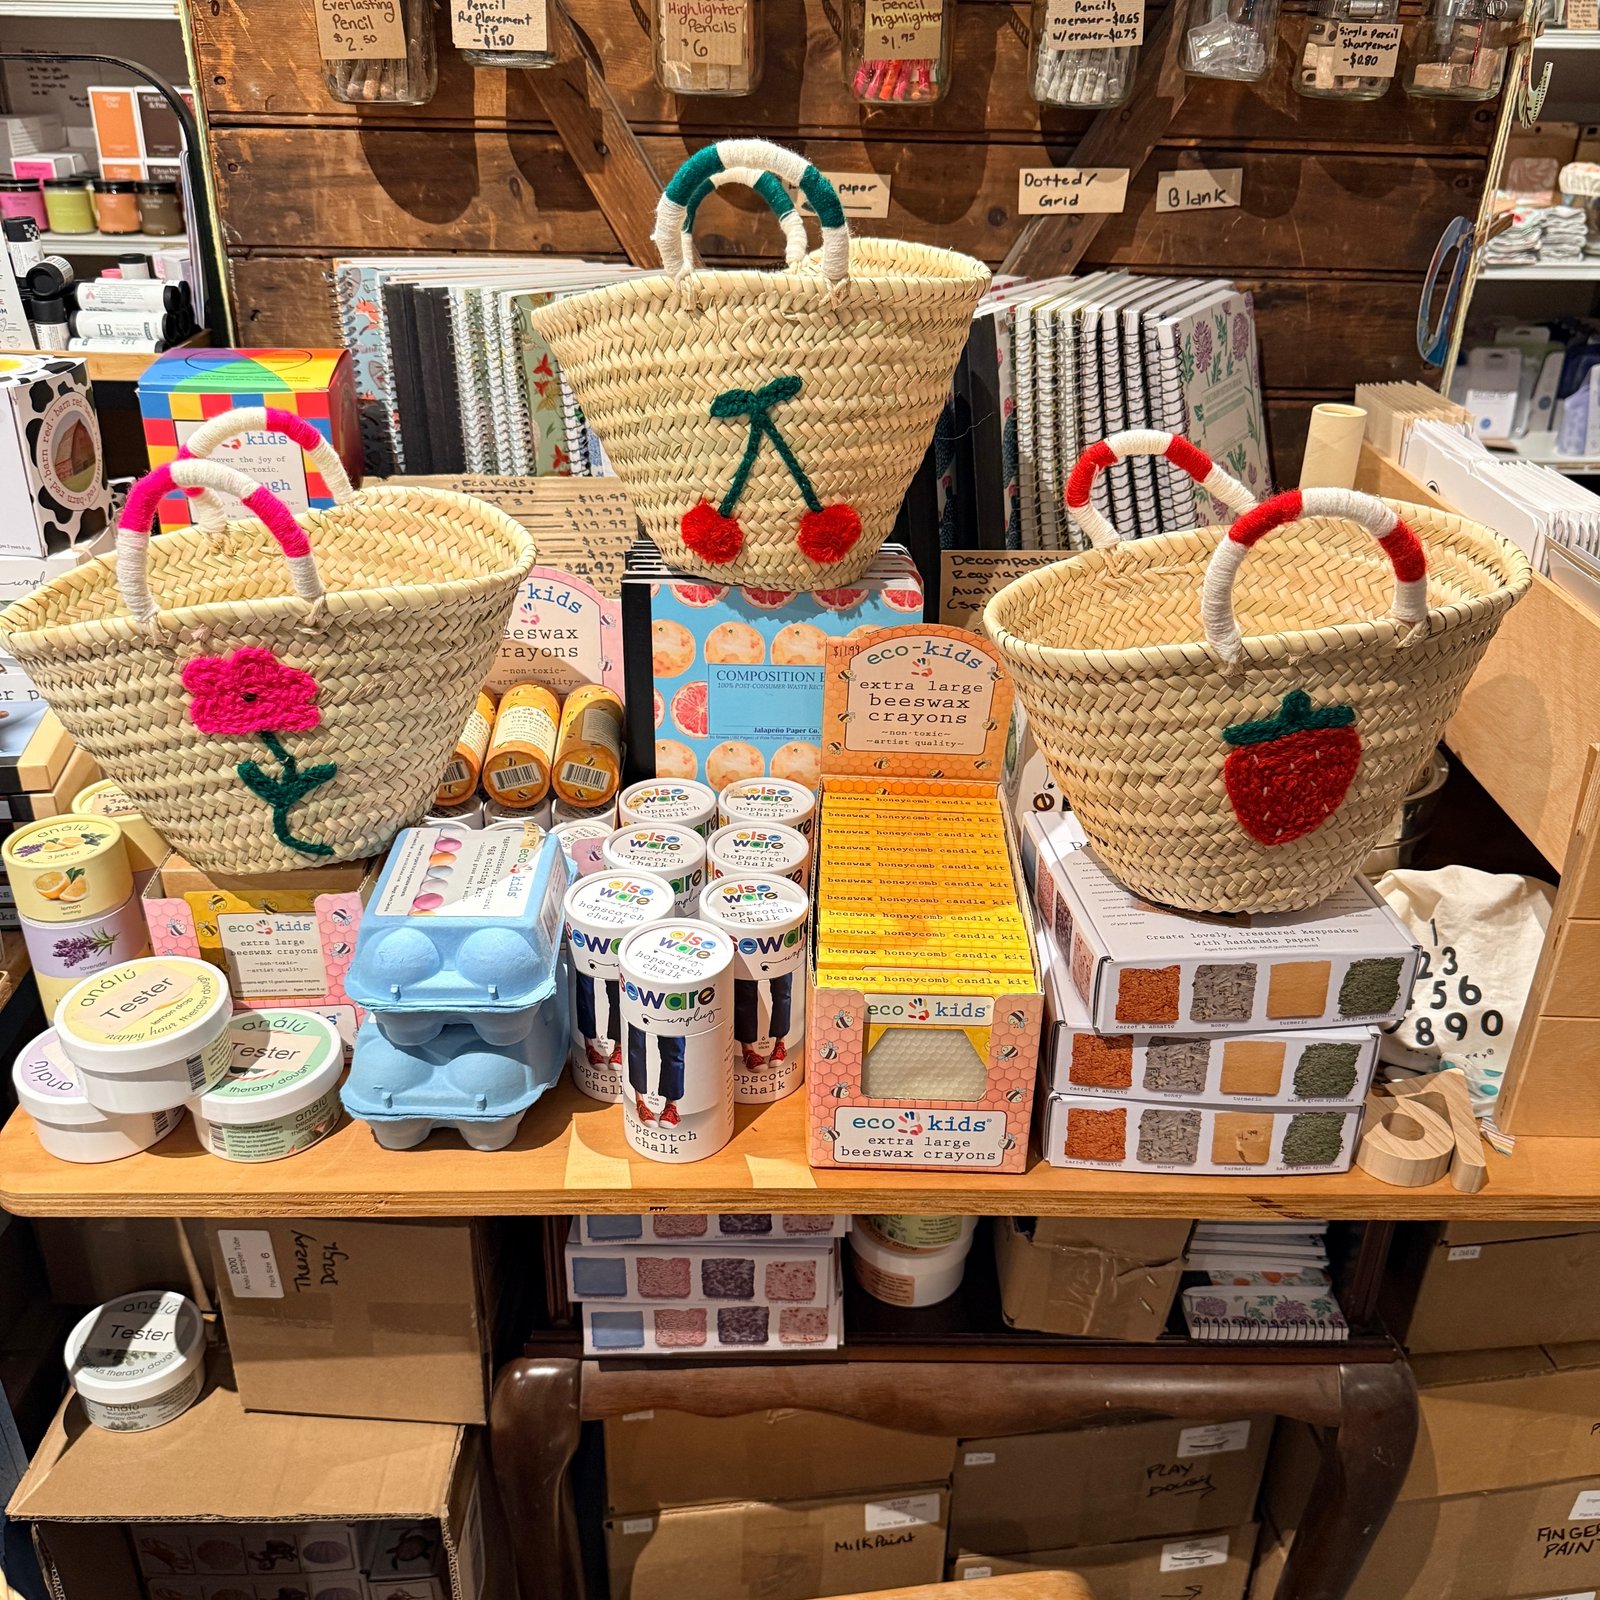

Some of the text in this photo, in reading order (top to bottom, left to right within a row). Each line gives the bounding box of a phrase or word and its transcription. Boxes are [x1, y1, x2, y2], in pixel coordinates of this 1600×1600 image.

[668, 1, 743, 24] Highlighter
[1075, 1, 1117, 12] Pencils
[333, 14, 364, 30] Pencil
[458, 10, 532, 26] Replacement
[872, 13, 942, 30] highlighter
[476, 25, 499, 35] Tip
[690, 20, 737, 34] Pencils
[1340, 26, 1398, 40] Single Pencil
[1343, 39, 1397, 51] Sharpener
[1024, 172, 1097, 191] Dotted/
[838, 183, 877, 199] paper
[1169, 187, 1228, 208] Blank
[1040, 195, 1079, 208] Grid
[53, 400, 71, 417] barn
[245, 432, 288, 447] kids
[42, 449, 53, 478] barn
[259, 456, 273, 465] joy
[276, 455, 287, 463] of
[462, 479, 488, 488] Eco
[578, 492, 628, 505] $19.99
[587, 548, 624, 561] $9.9
[503, 628, 579, 640] eeswax
[833, 645, 860, 659] $11.99
[867, 640, 984, 670] eco-kids
[716, 669, 816, 683] COMPOSITION
[859, 680, 983, 695] extra large
[869, 693, 972, 709] beeswax
[868, 711, 968, 726] crayons
[786, 728, 808, 736] Paper
[745, 795, 793, 803] ware
[629, 839, 682, 851] ware
[733, 839, 784, 850] ware
[877, 845, 933, 853] honeycomb
[629, 860, 668, 869] chalk
[736, 860, 774, 868] chalk
[506, 848, 530, 896] eco kids
[879, 879, 938, 887] honeycomb
[600, 887, 651, 906] ware
[723, 892, 778, 904] ware
[586, 912, 626, 925] chalk
[739, 915, 780, 924] chalk
[829, 910, 875, 918] beeswax
[883, 912, 943, 920] honeycomb
[228, 921, 311, 933] eco kids
[1146, 933, 1185, 941] Create
[1239, 929, 1296, 937] treasured
[1300, 927, 1359, 936] keepsakes
[1430, 918, 1438, 946] 1
[275, 938, 305, 948] large
[659, 937, 710, 960] ware
[276, 948, 318, 957] crayons
[828, 947, 876, 955] beeswax
[884, 949, 948, 958] honeycomb
[955, 951, 997, 959] candle
[1416, 946, 1458, 980] 2 3
[641, 962, 682, 980] chalk
[826, 974, 876, 982] beeswax
[884, 975, 949, 985] honeycomb
[957, 977, 1000, 985] candle
[100, 978, 173, 1020] Tester
[1430, 975, 1482, 1010] 5 6
[179, 992, 211, 1023] therapy
[866, 1001, 986, 1018] eco kids
[150, 1007, 176, 1025] lemon
[667, 1007, 722, 1028] unplug
[1415, 1009, 1504, 1046] 8 9 0
[231, 1042, 301, 1061] Tester
[229, 1063, 311, 1094] therapy dough
[740, 1080, 786, 1095] chalk
[852, 1115, 985, 1132] eco kids
[634, 1135, 679, 1155] chalk
[868, 1136, 971, 1149] extra large
[840, 1146, 996, 1163] beeswax crayons
[110, 1324, 174, 1342] Tester
[106, 1367, 145, 1378] therapy
[1146, 1463, 1194, 1480] PLAY
[1542, 1538, 1600, 1559] PAIN
